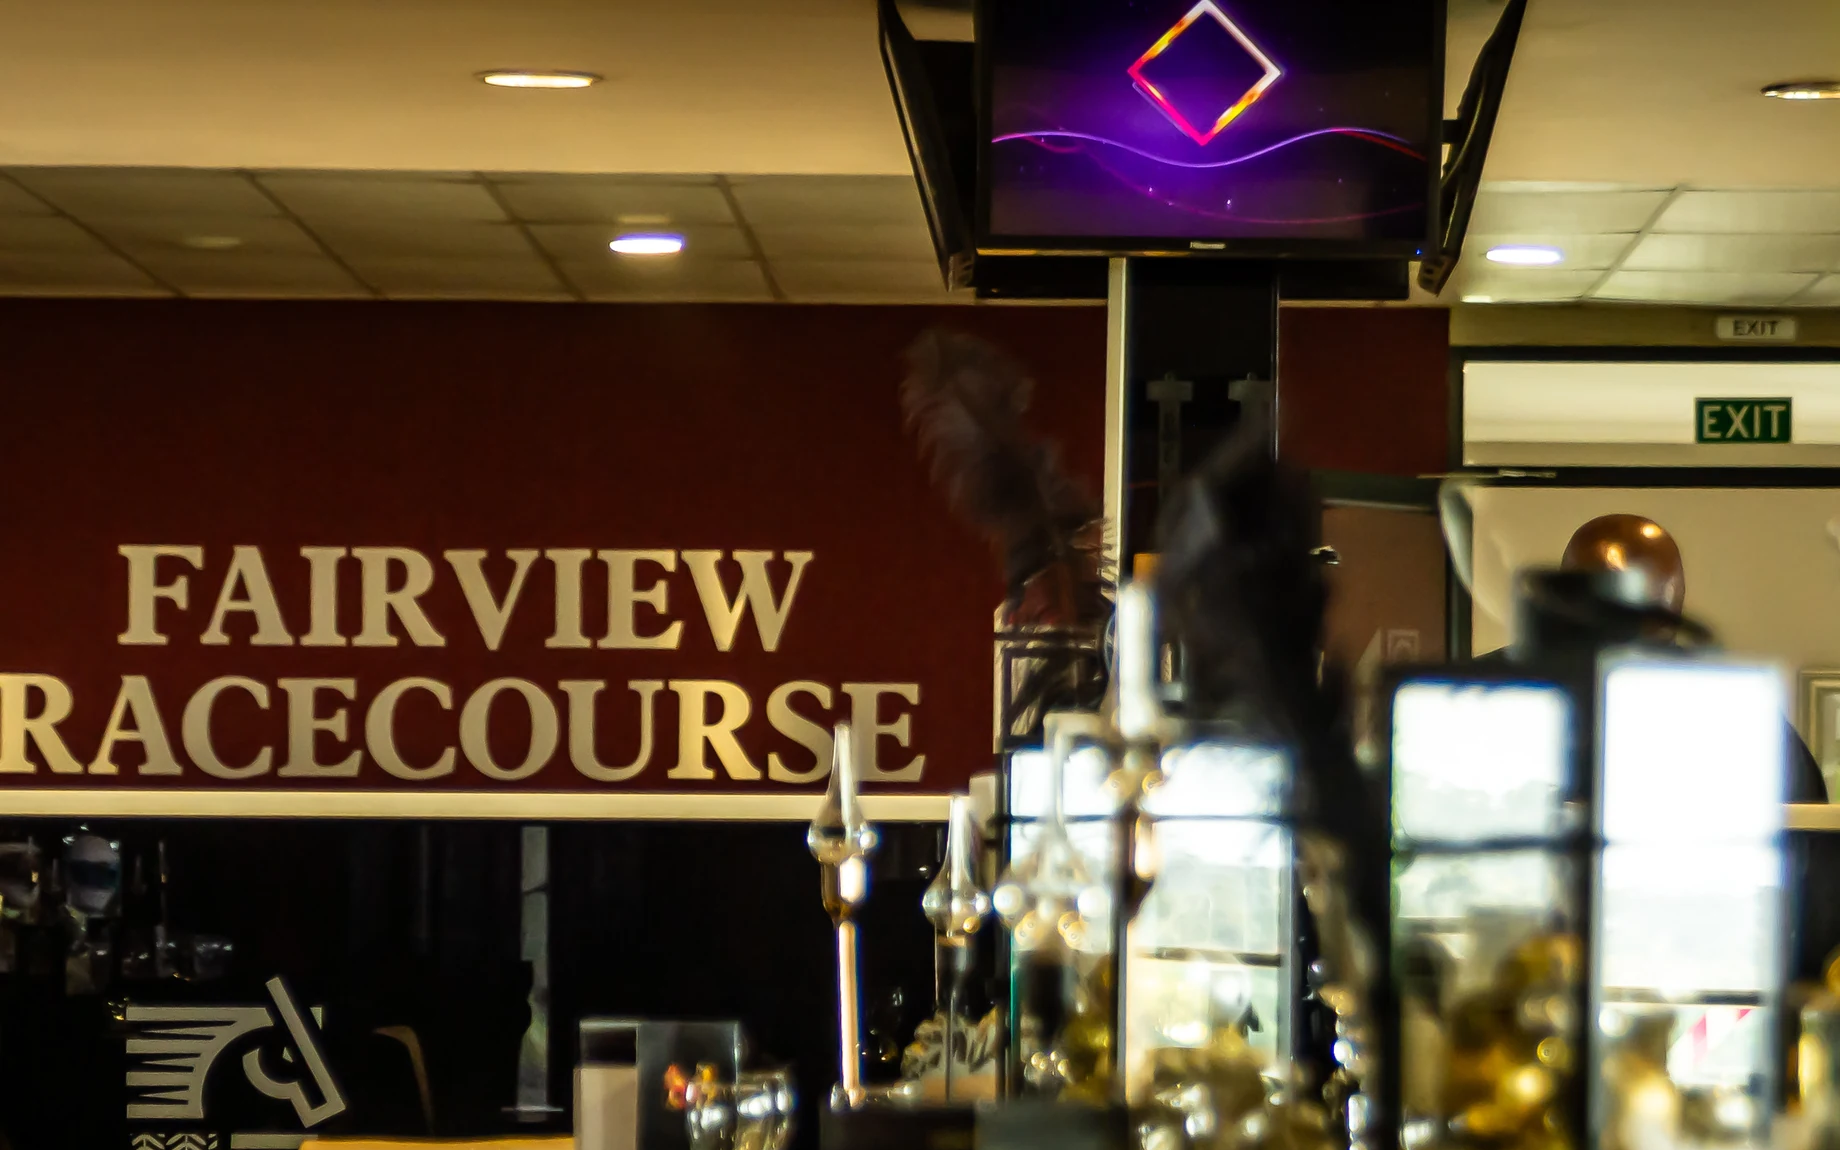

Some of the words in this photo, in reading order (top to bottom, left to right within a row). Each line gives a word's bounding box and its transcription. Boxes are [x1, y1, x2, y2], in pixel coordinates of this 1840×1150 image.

[1732, 319, 1779, 337] EXIT
[1703, 405, 1786, 438] EXIT
[118, 545, 813, 652] FAIRVIEW
[0, 672, 926, 783] RACECOURSE
